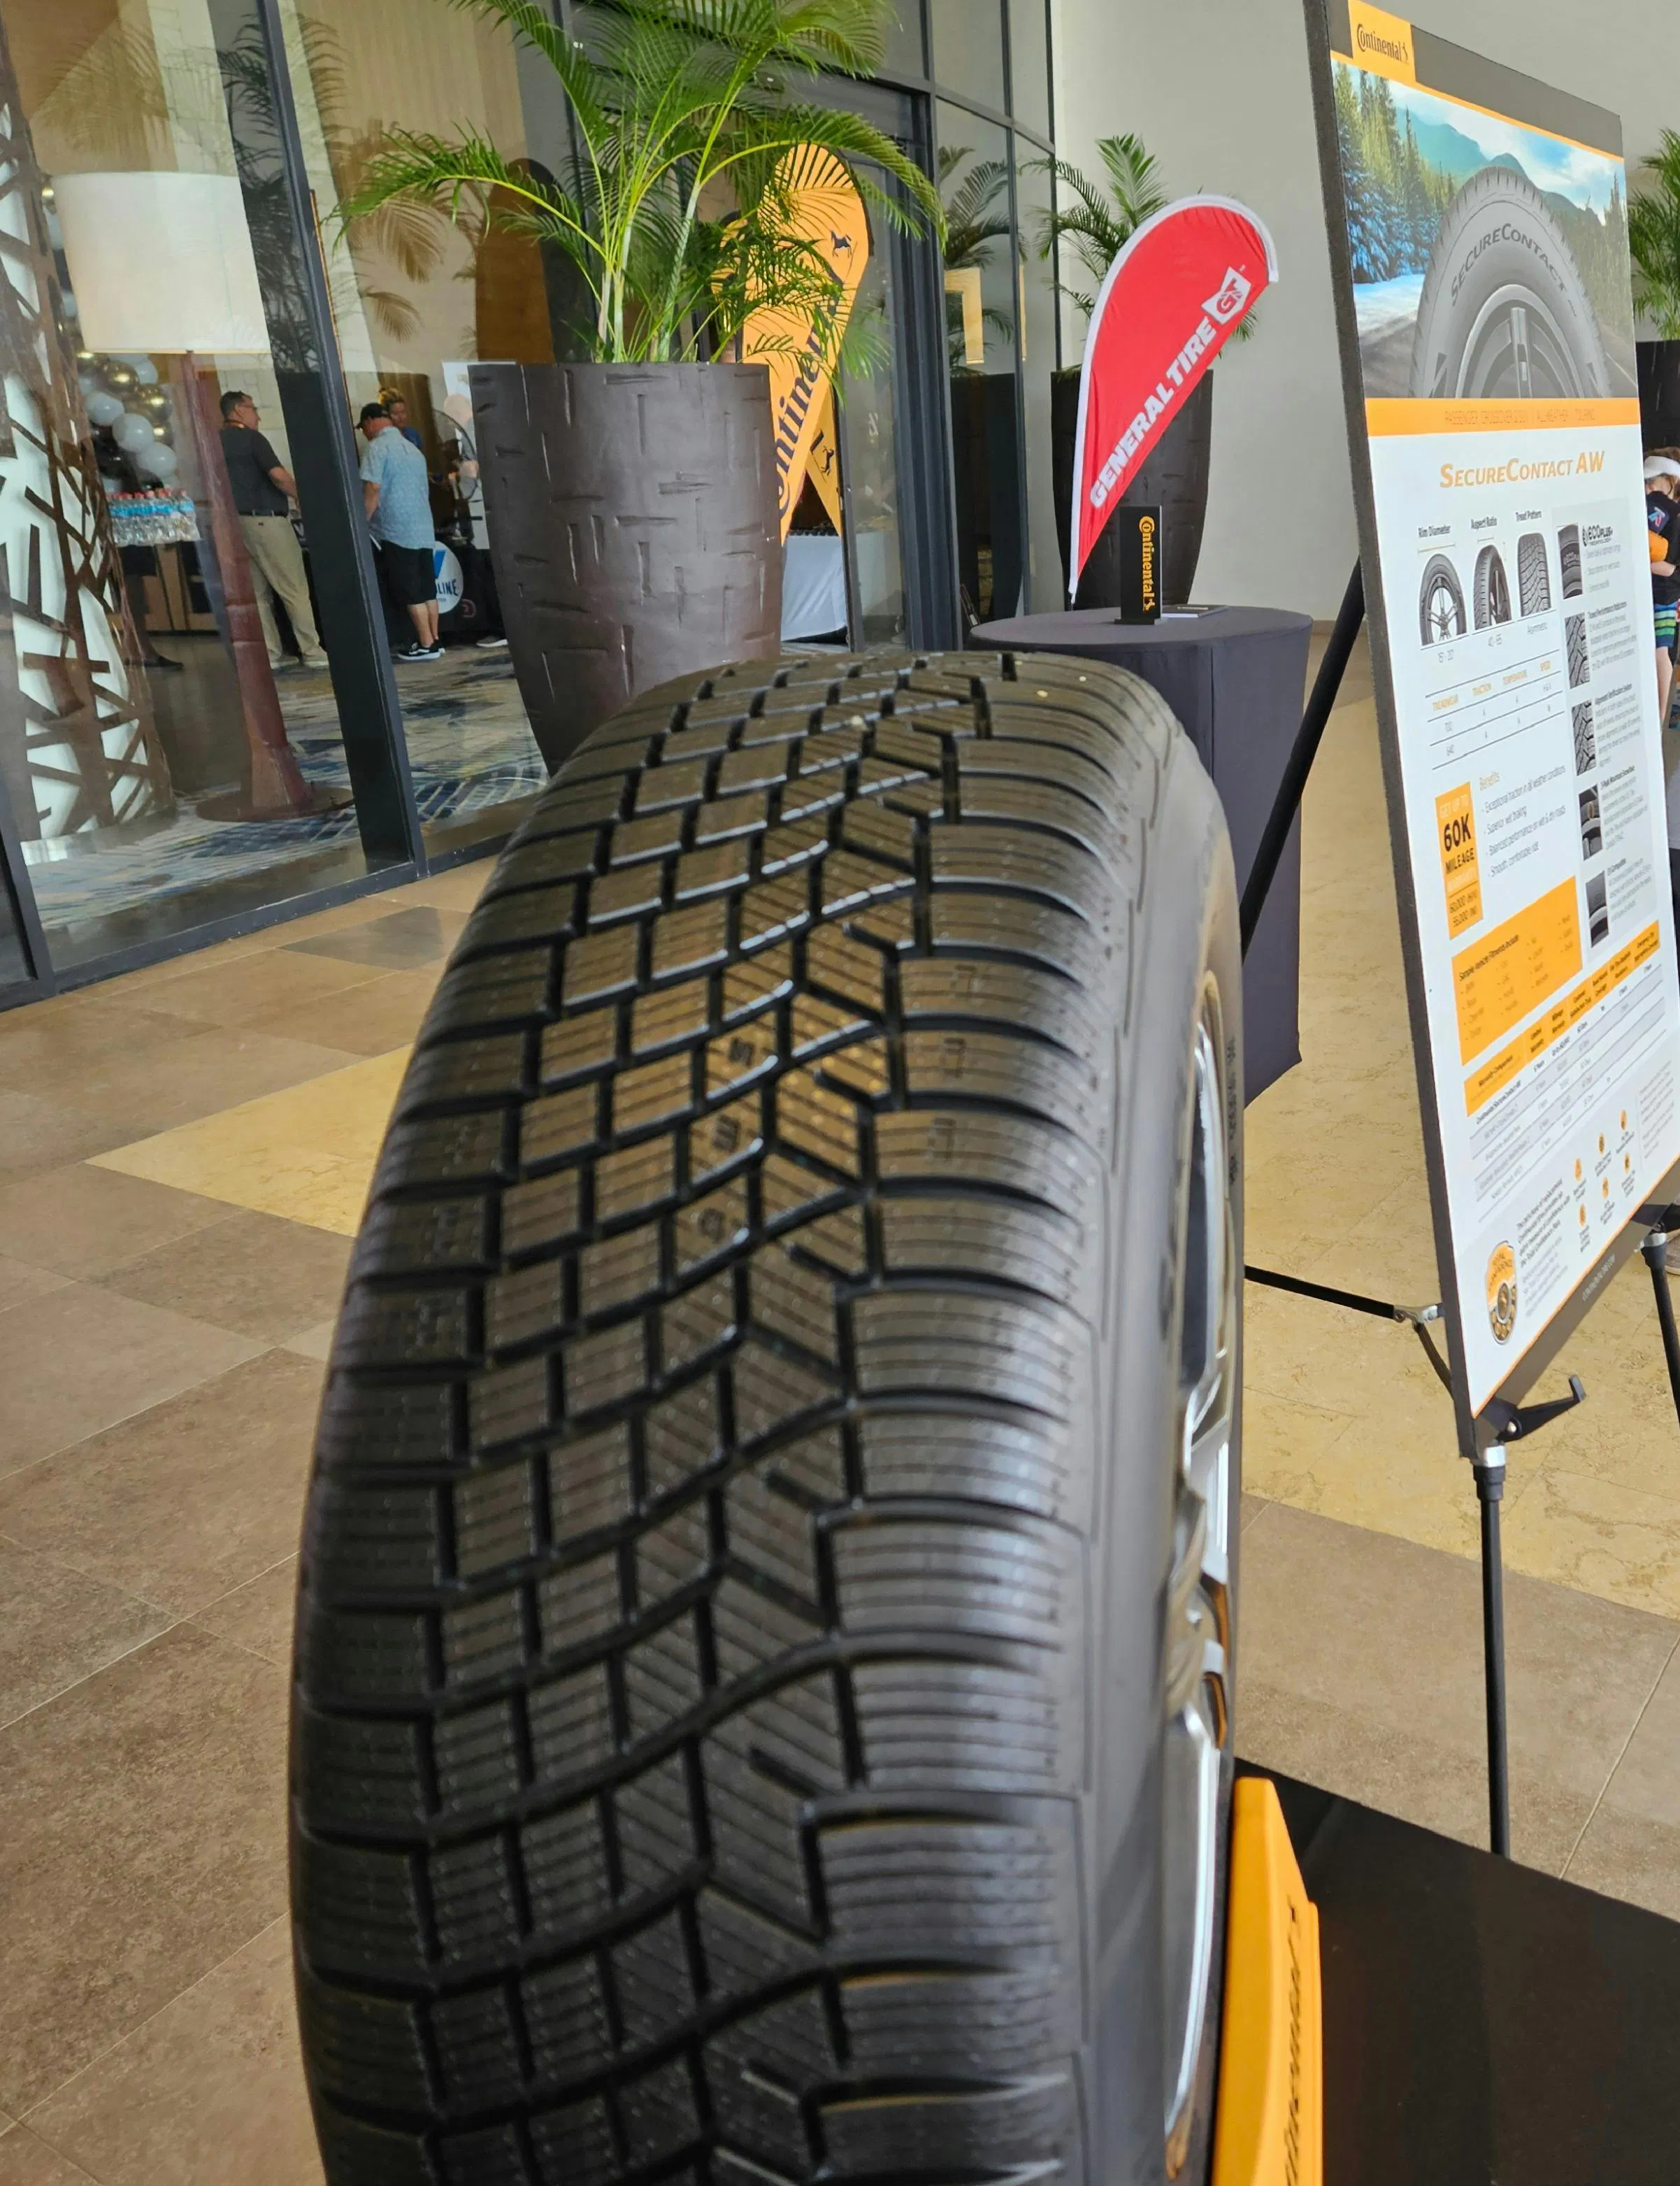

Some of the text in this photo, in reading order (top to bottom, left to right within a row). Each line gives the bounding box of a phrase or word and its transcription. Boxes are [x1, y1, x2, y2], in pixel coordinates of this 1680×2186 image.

[1356, 23, 1402, 62] Continental
[1090, 315, 1217, 508] GENERAL TIRE
[1575, 450, 1605, 475] AW
[1139, 515, 1155, 599] Continental
[1444, 813, 1471, 852] 60K
[1446, 847, 1474, 874] MILEAGE
